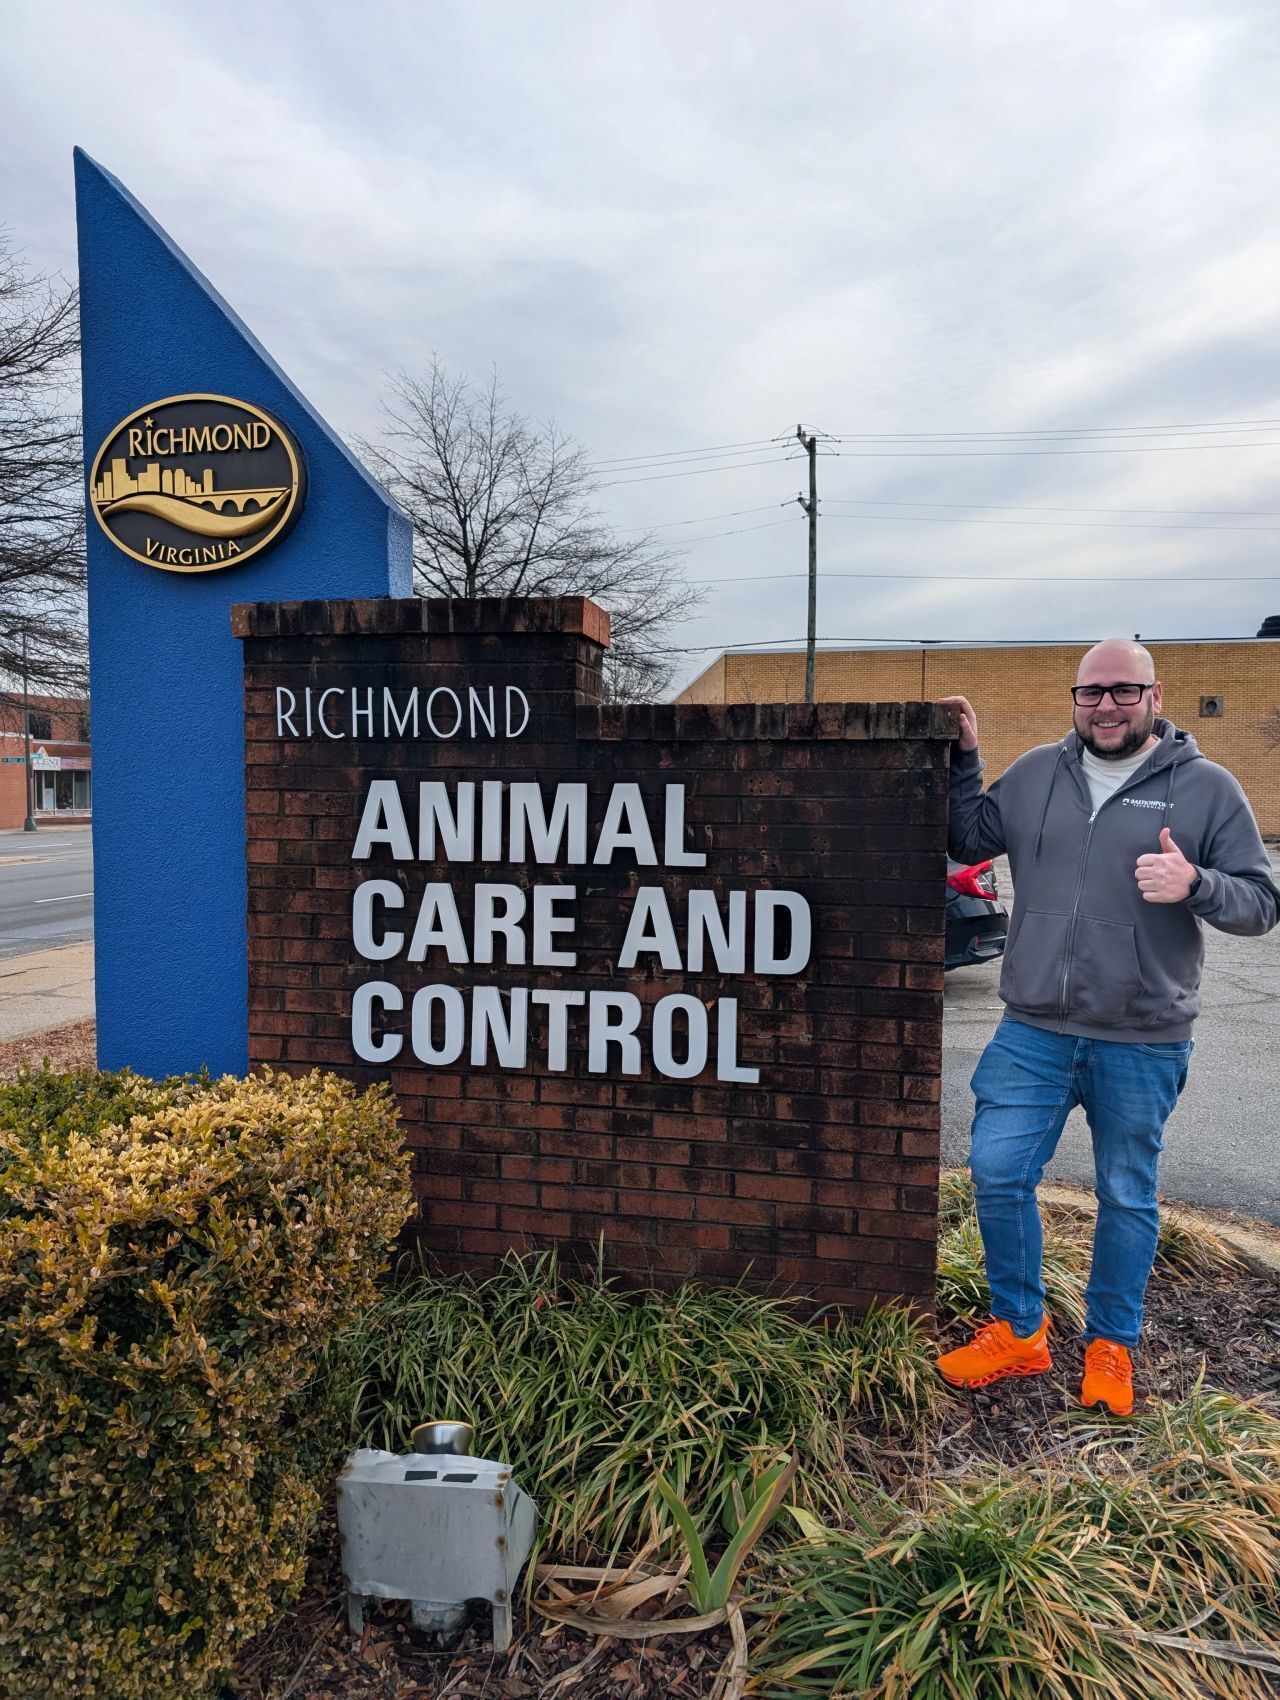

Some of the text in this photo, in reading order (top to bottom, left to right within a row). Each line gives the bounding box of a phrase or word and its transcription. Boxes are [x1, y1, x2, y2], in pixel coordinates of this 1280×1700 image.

[128, 422, 271, 457] RICHMOND
[146, 537, 241, 565] VIRGINIA
[276, 685, 530, 739] RICHMOND
[351, 779, 707, 868] ANIMAL
[1130, 799, 1175, 809] BASTIONPOIT
[352, 879, 812, 975] CARE AND
[351, 980, 760, 1084] CONTROL
